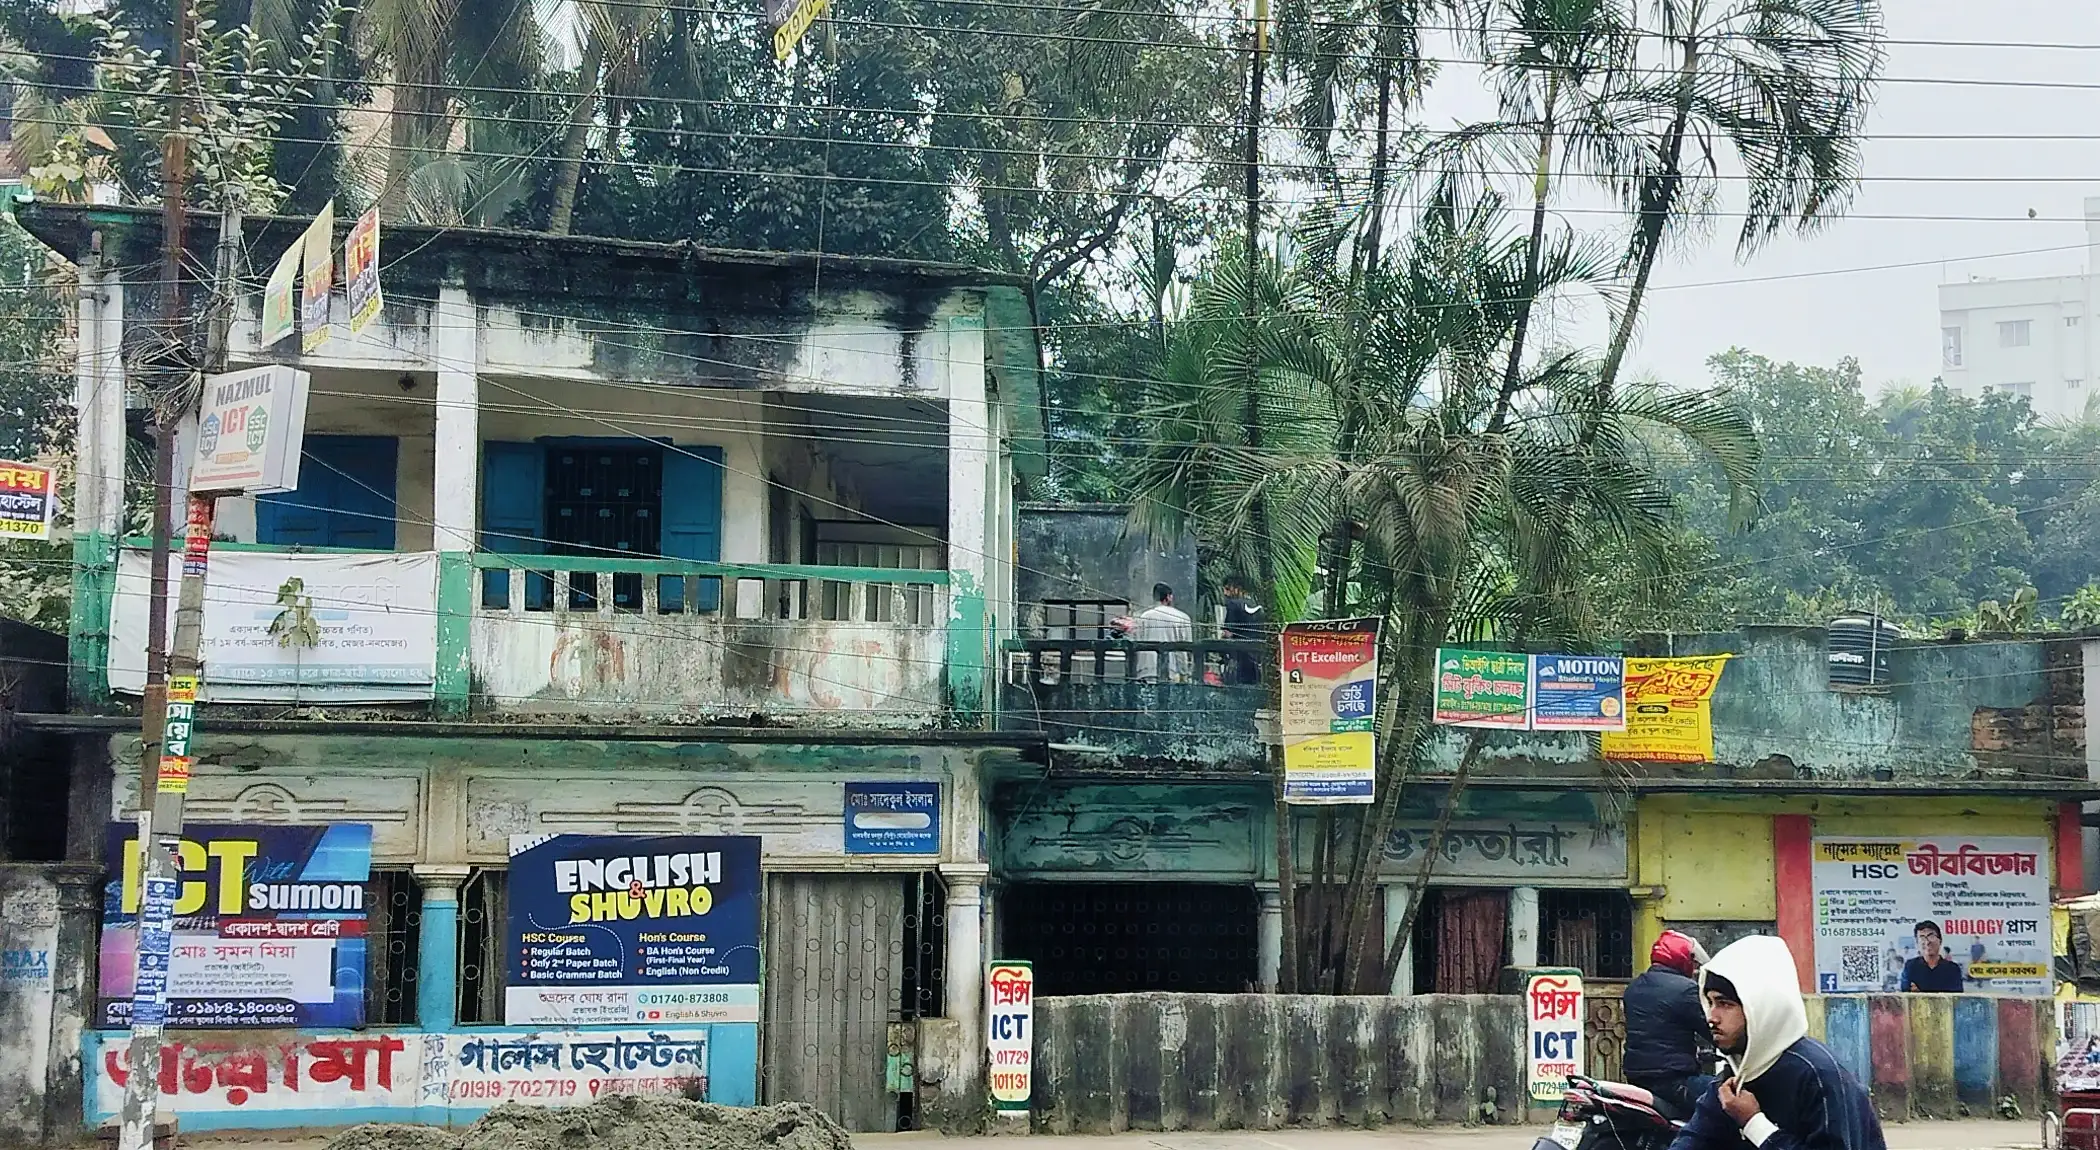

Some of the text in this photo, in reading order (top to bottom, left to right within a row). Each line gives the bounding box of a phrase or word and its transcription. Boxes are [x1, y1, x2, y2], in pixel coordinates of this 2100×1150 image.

[216, 373, 271, 407] NAZMUL
[221, 405, 248, 435] ICT
[249, 414, 266, 429] SSC
[200, 436, 217, 451] ICT
[247, 429, 264, 445] ICT
[1292, 652, 1309, 662] ICT
[1558, 660, 1620, 675] MOTION
[1341, 685, 1363, 700] ভর্তি
[1441, 672, 1525, 700] সিট বুকিং চলছে
[1337, 700, 1366, 712] চলছে
[1906, 844, 2037, 876] জীববিজ্ঞান
[121, 840, 257, 915] ICT
[555, 852, 721, 892] ENGLISH
[1852, 864, 1899, 879] HSC
[629, 880, 647, 898] &
[249, 884, 363, 910] sumon
[568, 886, 712, 923] SHUVRO
[225, 919, 341, 936] একাদশ-দ্বাদশ শ্রেণি
[1821, 928, 1885, 937] 01687858344
[1945, 919, 2038, 934] BIOLOGY প্লাস
[522, 933, 586, 943] HSC Course
[639, 932, 706, 942] Hon's Course
[173, 942, 297, 963] মোঃ সুমন মিয়া
[531, 947, 591, 957] Regular Batch
[646, 946, 715, 955] BA Hon's Course
[531, 959, 550, 969] Only
[566, 958, 591, 969] Paper
[593, 958, 618, 967] Batch
[646, 955, 706, 965] (First-Final Year)
[530, 970, 623, 979] Basic Grammar Batch
[646, 965, 729, 977] English (Non Credit)
[990, 968, 1031, 1006] প্রিন্স
[580, 993, 603, 1003] ঘোষ
[606, 992, 628, 1003] রানা
[651, 993, 728, 1003] 01740-873808
[1530, 978, 1581, 1020] প্রিন্স
[187, 1002, 295, 1014] ০১৯৮৪-১৪০০৬০
[665, 1011, 693, 1019] English
[701, 1010, 727, 1018] Shuvro
[992, 1014, 1029, 1040] ICT
[570, 1031, 705, 1074] হোস্টেল
[1534, 1031, 1577, 1059] ICT
[996, 1050, 1029, 1065] 01729
[993, 1073, 1028, 1090] 101131
